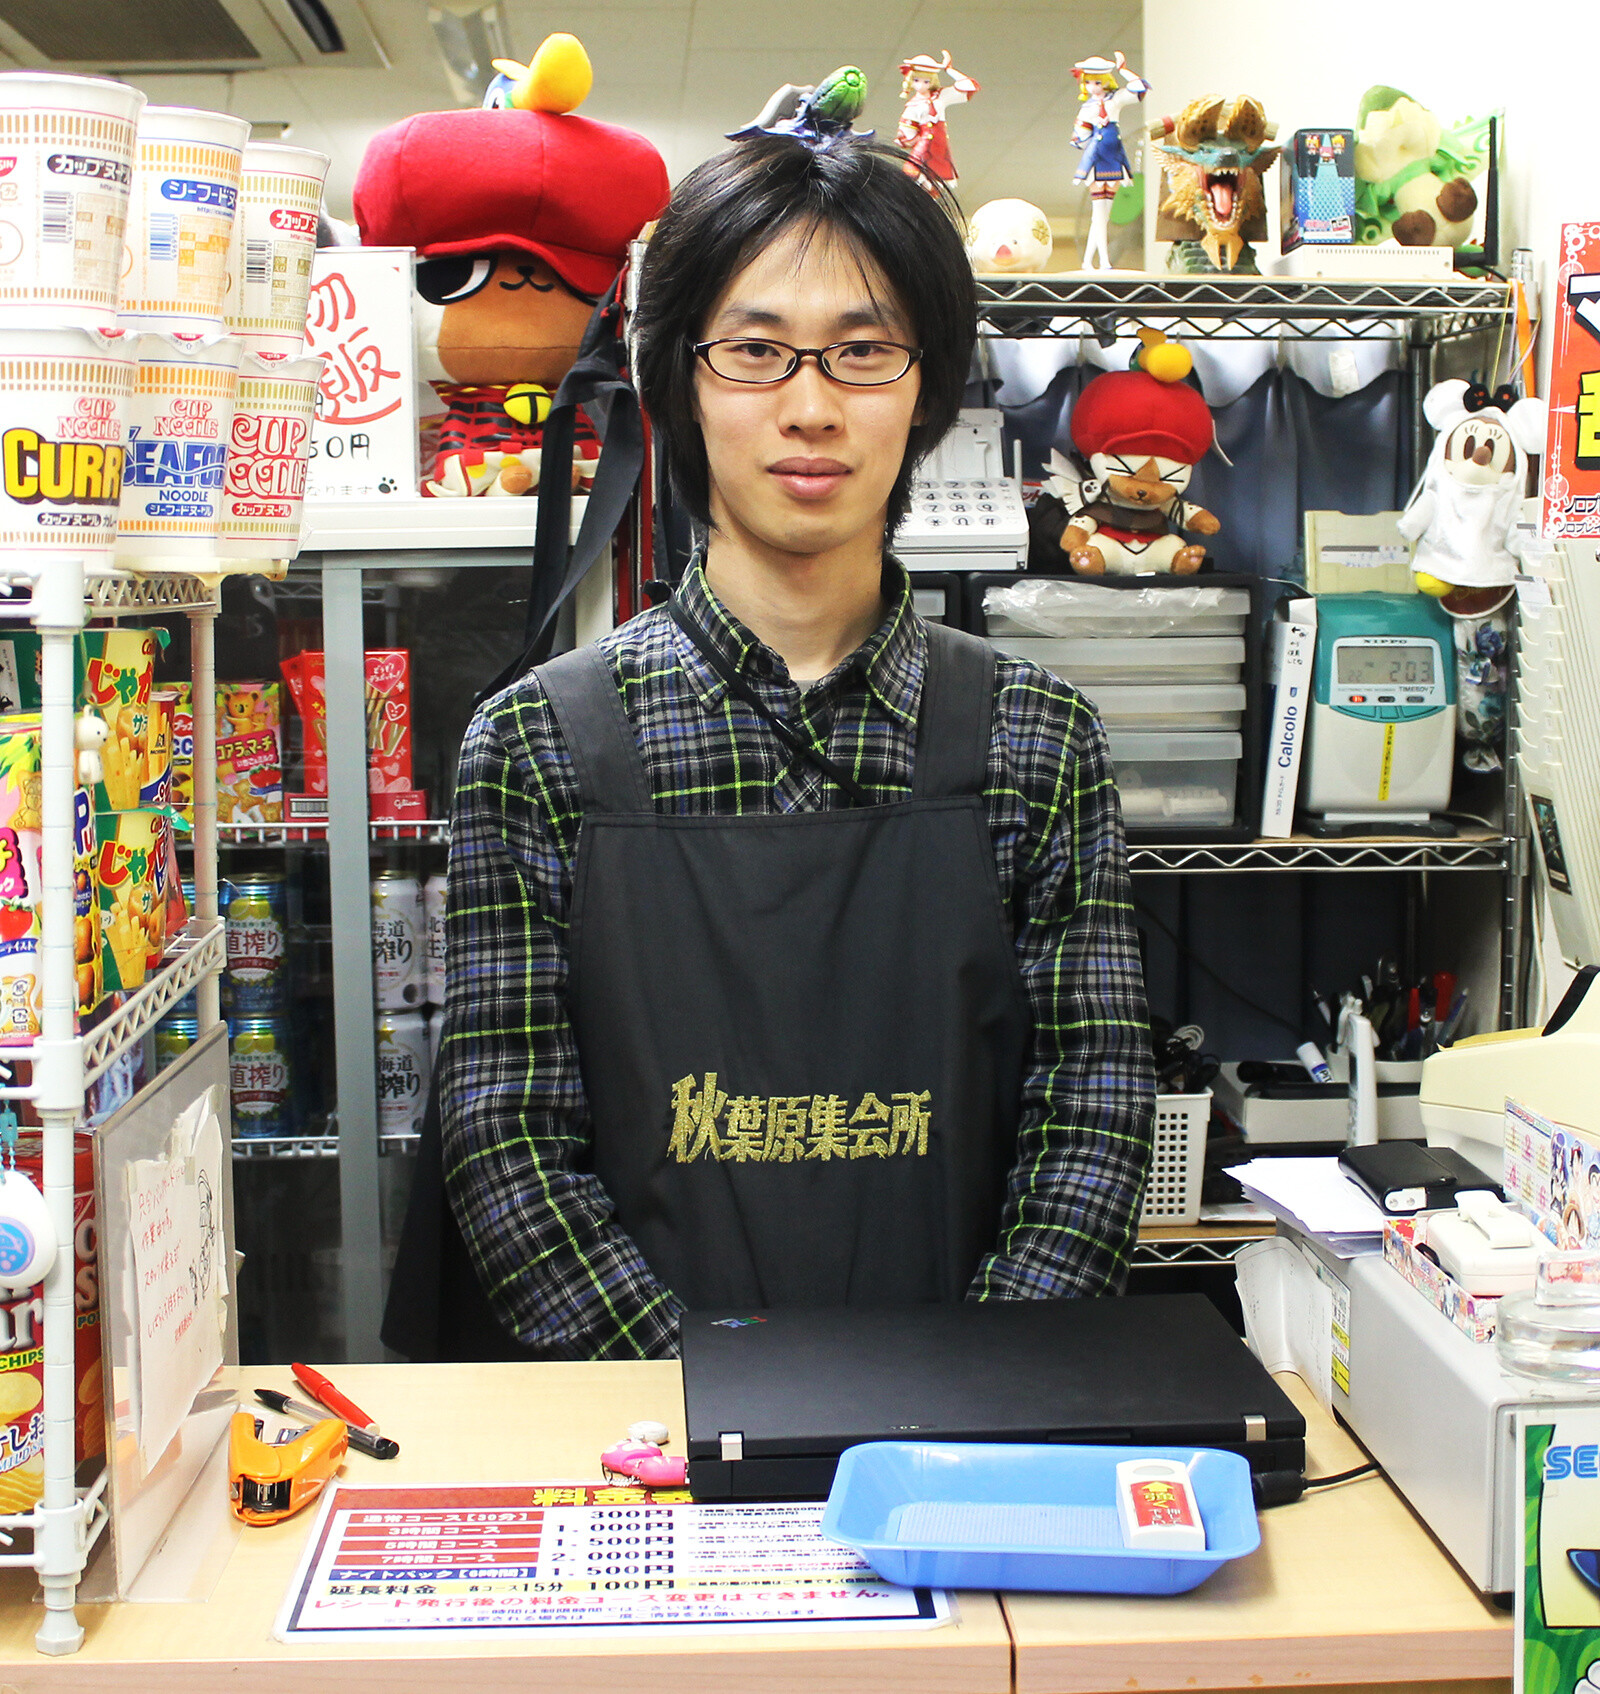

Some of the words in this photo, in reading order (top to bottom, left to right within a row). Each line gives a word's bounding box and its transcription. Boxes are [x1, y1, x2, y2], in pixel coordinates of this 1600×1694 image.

[74, 396, 117, 418] CUP
[170, 398, 213, 417] CUP
[56, 415, 121, 441] NOODLE
[154, 415, 219, 438] NOODLE
[231, 413, 307, 458] CUP
[159, 490, 208, 502] NOODLE
[149, 503, 213, 517] シーフードヌードル
[236, 503, 291, 517] カップヌードル
[40, 514, 100, 527] カップヌードル
[1278, 706, 1297, 768] Calcolo
[226, 929, 279, 955] 直搾り
[230, 1062, 284, 1089] 直搾り
[667, 1072, 932, 1163] 秋葉原集会所
[1546, 1445, 1600, 1480] SE
[363, 1512, 528, 1523] 通常コース【30分】
[590, 1509, 673, 1519] 300円
[388, 1526, 501, 1535] 3時間コース
[385, 1540, 498, 1549] 5時間コース
[381, 1554, 496, 1563] 7時間コース
[329, 1584, 437, 1595] 延長料金
[590, 1580, 675, 1590] 100円
